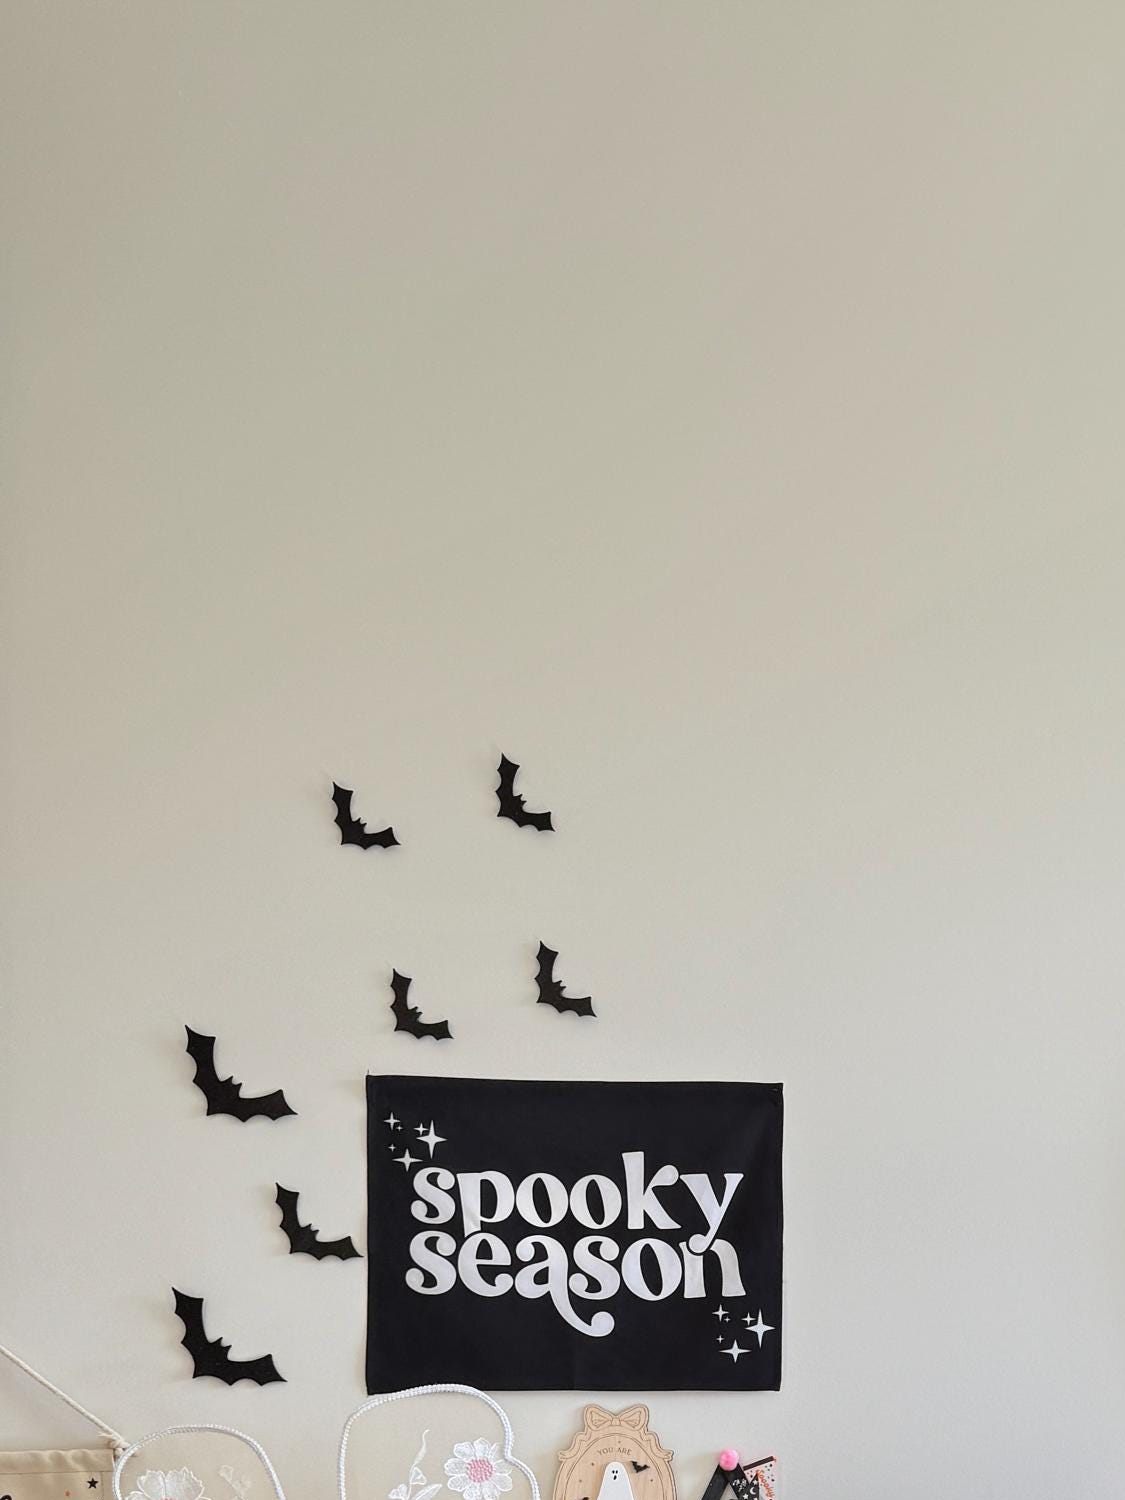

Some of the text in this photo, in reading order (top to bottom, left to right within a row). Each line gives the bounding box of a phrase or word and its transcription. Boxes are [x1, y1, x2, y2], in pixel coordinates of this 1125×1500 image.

[410, 1151, 744, 1254] spooky
[405, 1230, 746, 1337] season
[597, 1446, 632, 1456] YOU ARE
